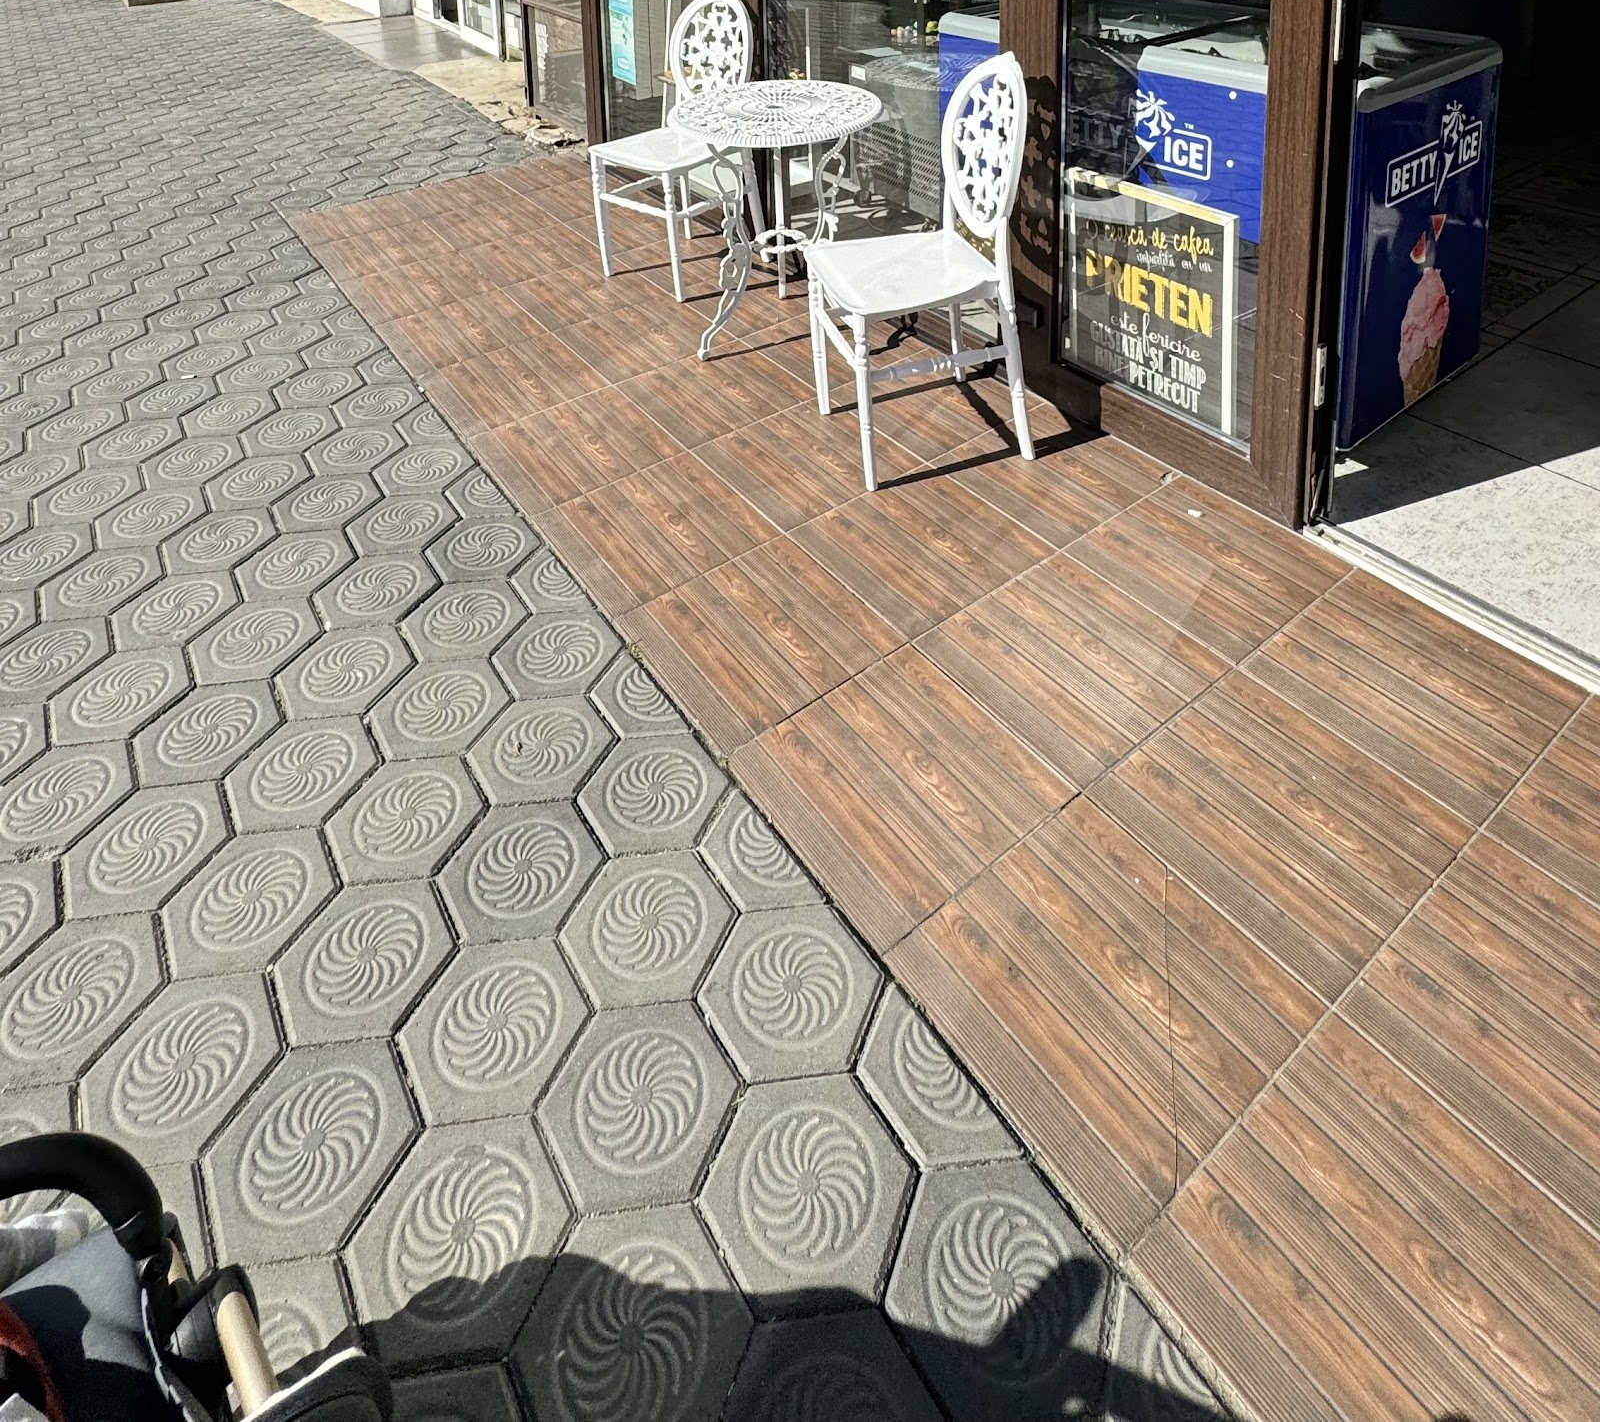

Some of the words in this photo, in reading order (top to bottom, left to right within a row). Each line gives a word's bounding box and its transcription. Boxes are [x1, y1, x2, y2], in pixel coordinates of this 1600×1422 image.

[1163, 136, 1204, 172] ICE
[1390, 150, 1438, 198] BETTY
[1458, 131, 1479, 165] ICE
[1152, 227, 1168, 250] de
[1173, 225, 1214, 265] cafea
[1085, 248, 1213, 338] PRIETEN
[1091, 320, 1145, 364] GUSTATĂ
[1169, 353, 1207, 391] TIMP
[1110, 311, 1139, 335] este
[1142, 312, 1202, 362] fericire
[1095, 345, 1125, 378] BINE
[1129, 360, 1201, 414] PETRECUT
